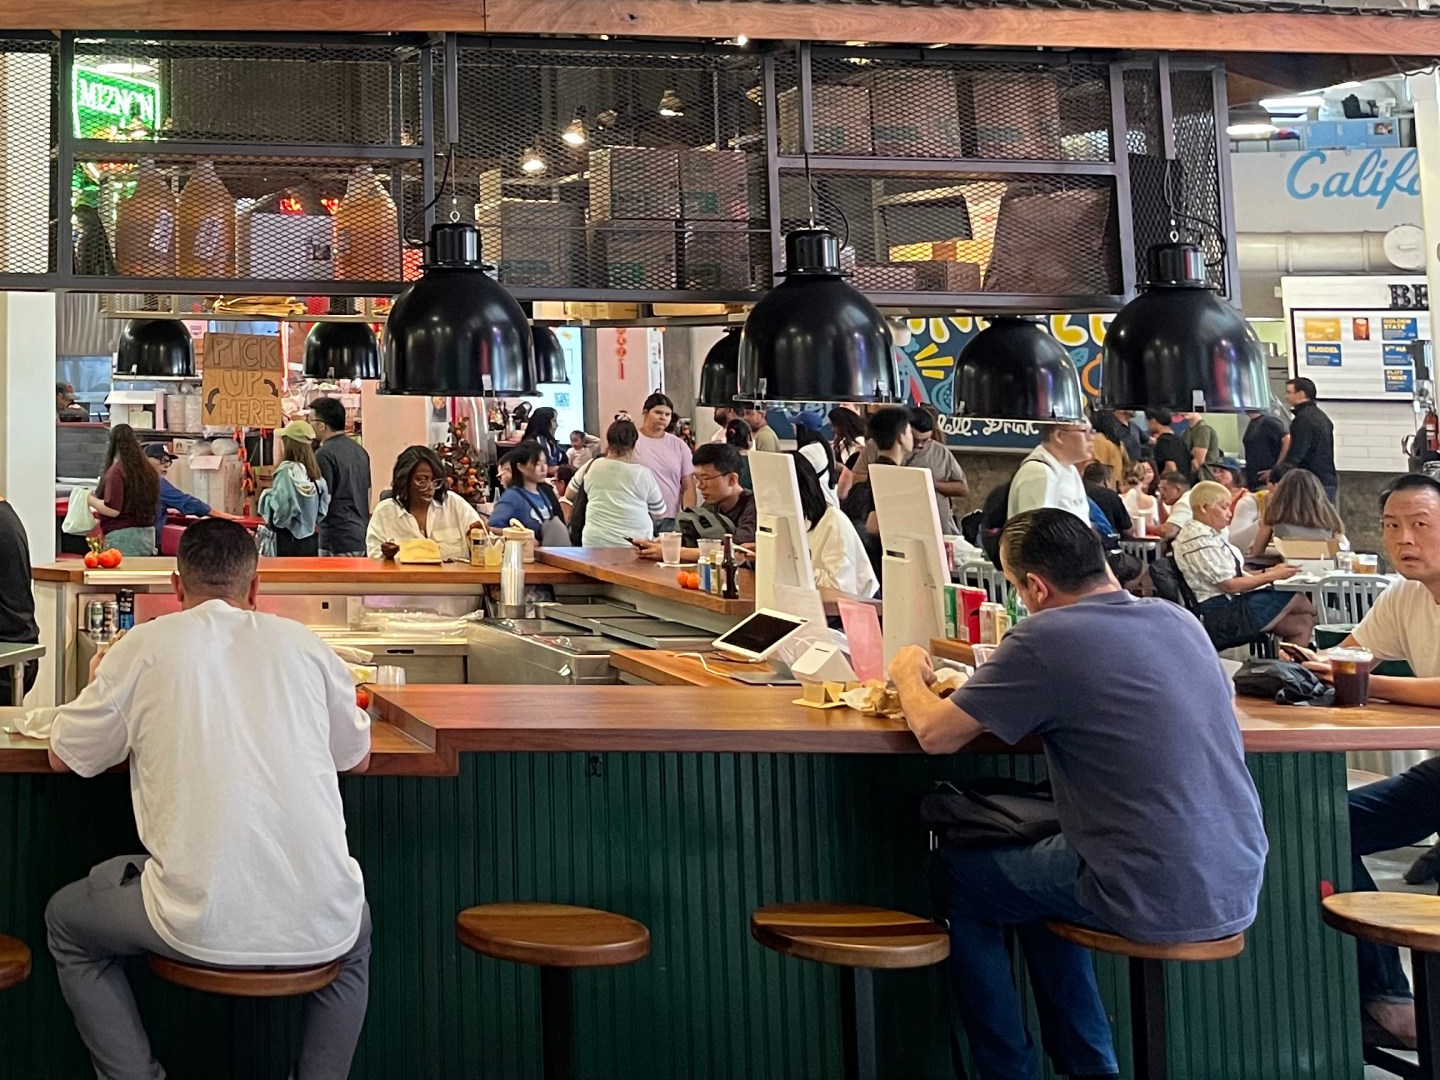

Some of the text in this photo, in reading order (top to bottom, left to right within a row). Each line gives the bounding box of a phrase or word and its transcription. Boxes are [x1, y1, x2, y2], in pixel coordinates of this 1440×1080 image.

[211, 337, 282, 368] PICK
[221, 369, 257, 396] UP
[219, 397, 277, 426] HERE
